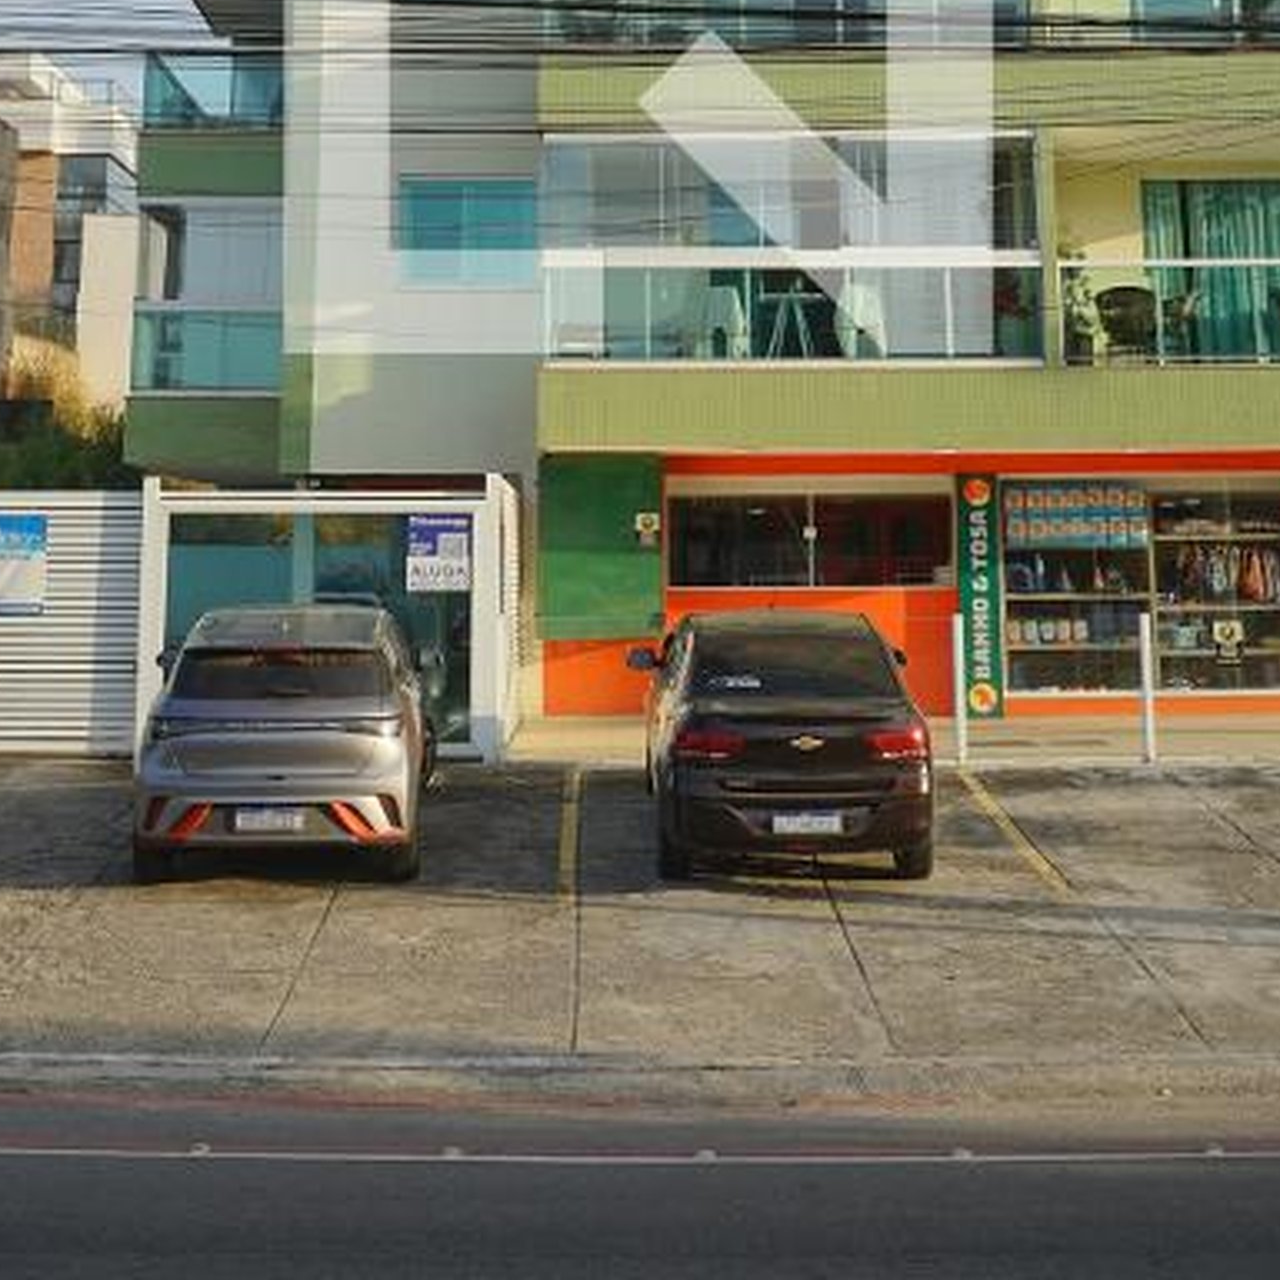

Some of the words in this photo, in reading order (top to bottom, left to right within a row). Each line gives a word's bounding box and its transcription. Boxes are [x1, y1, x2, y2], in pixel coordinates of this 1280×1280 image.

[969, 510, 988, 569] TOSA
[972, 575, 988, 592] &
[972, 597, 991, 679] BANHO
